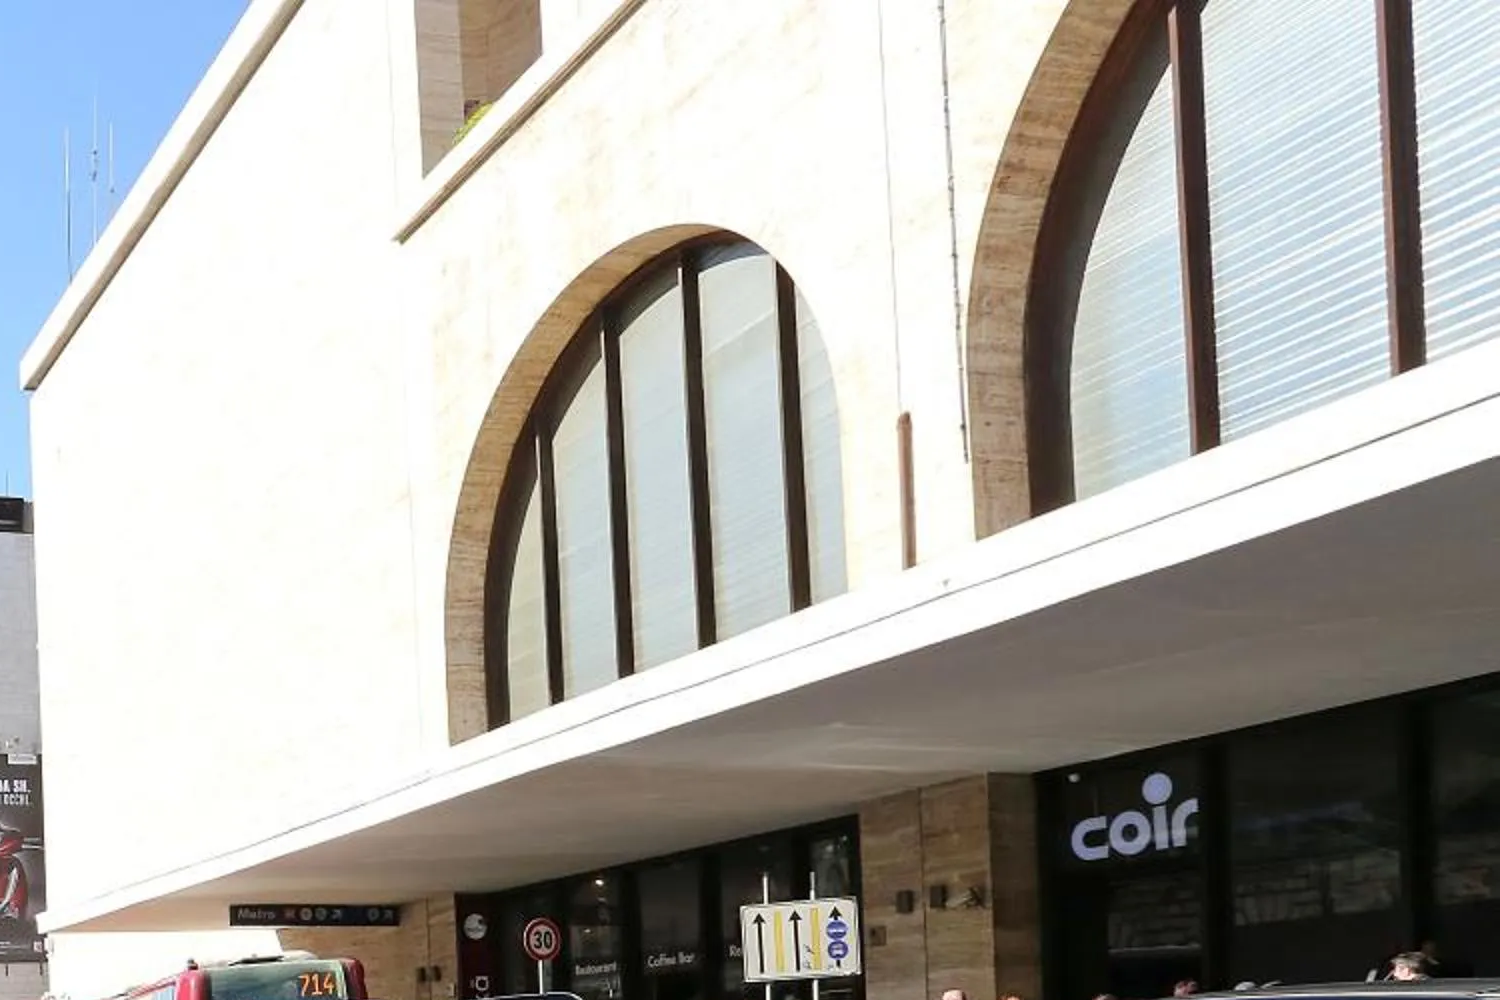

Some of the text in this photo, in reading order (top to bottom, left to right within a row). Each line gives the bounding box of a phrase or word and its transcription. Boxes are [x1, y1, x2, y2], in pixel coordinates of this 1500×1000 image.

[533, 931, 552, 949] 30
[678, 951, 695, 964] Bar
[300, 972, 335, 997] 714
